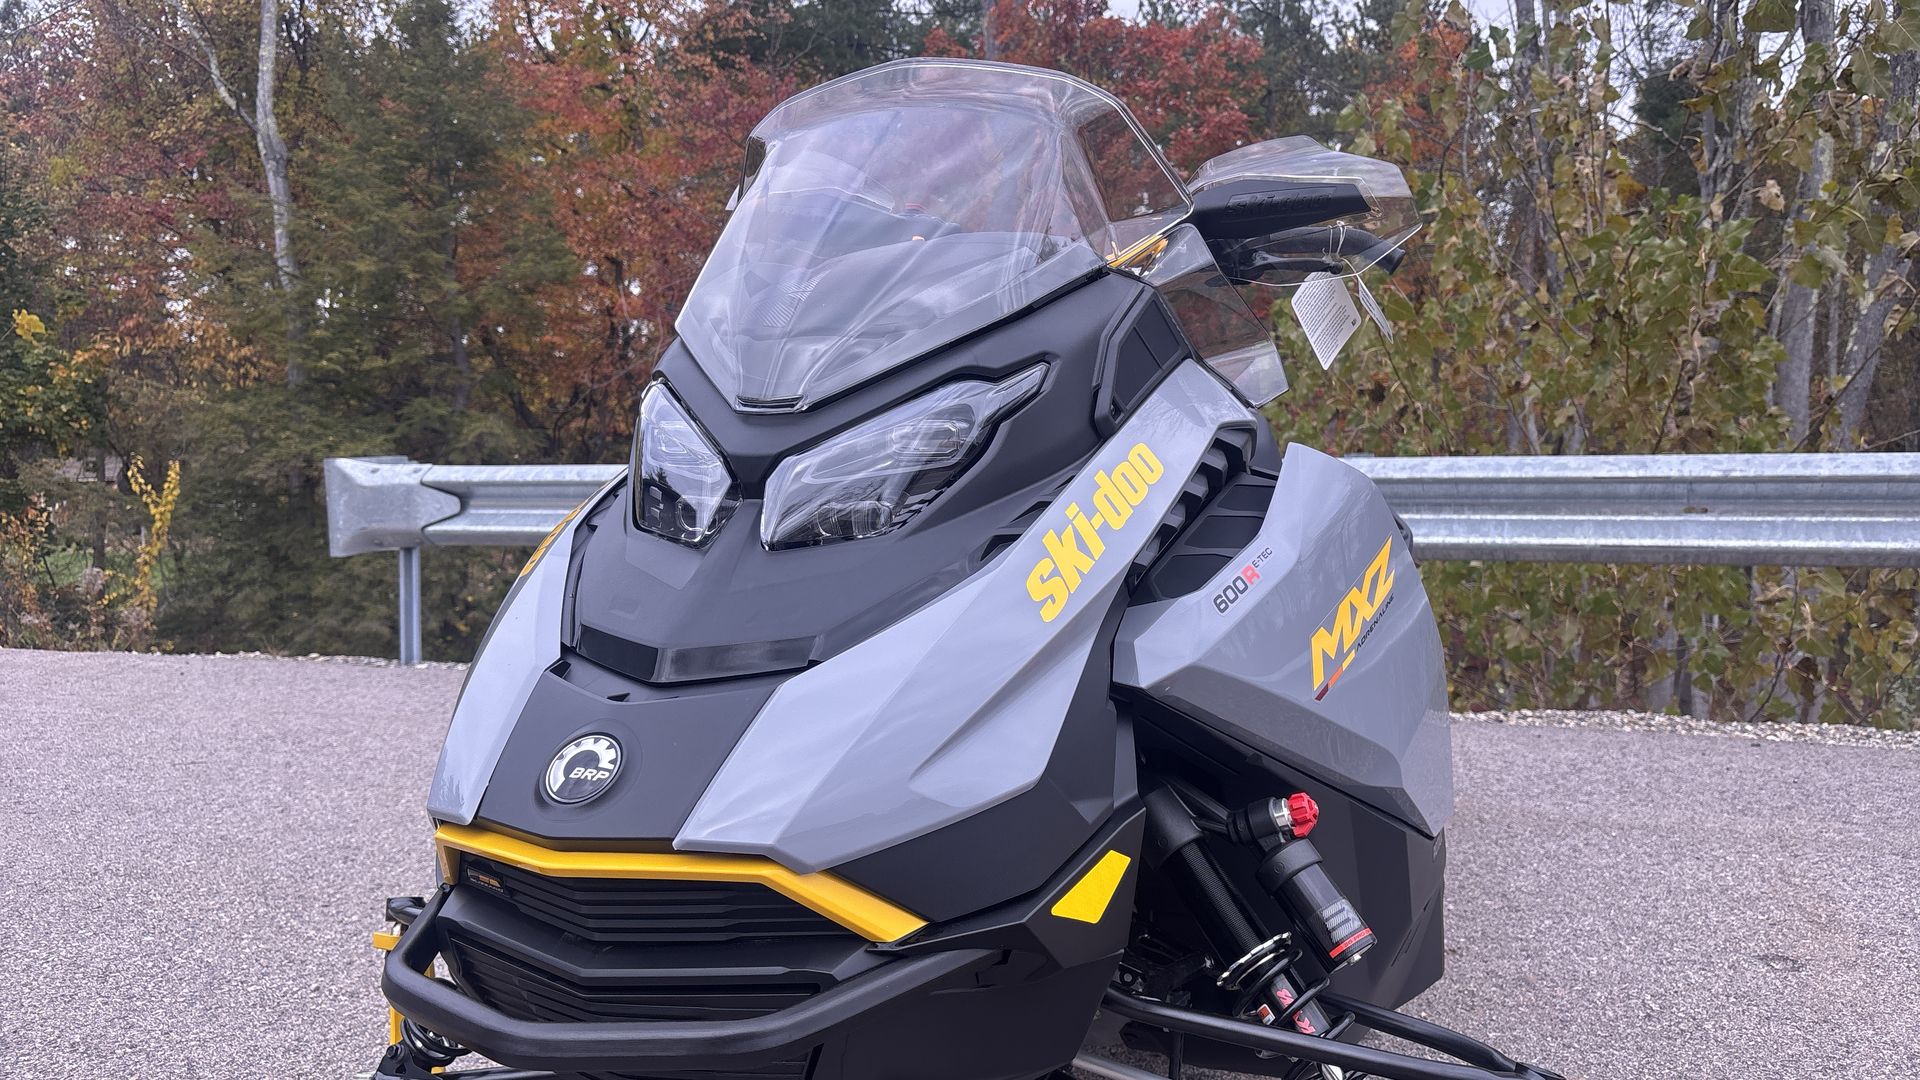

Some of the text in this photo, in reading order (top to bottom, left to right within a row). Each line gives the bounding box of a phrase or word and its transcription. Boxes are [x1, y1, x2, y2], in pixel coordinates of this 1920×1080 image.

[1251, 547, 1273, 569] E-TEC
[1310, 534, 1396, 691] MXZ
[568, 766, 610, 781] BRP
